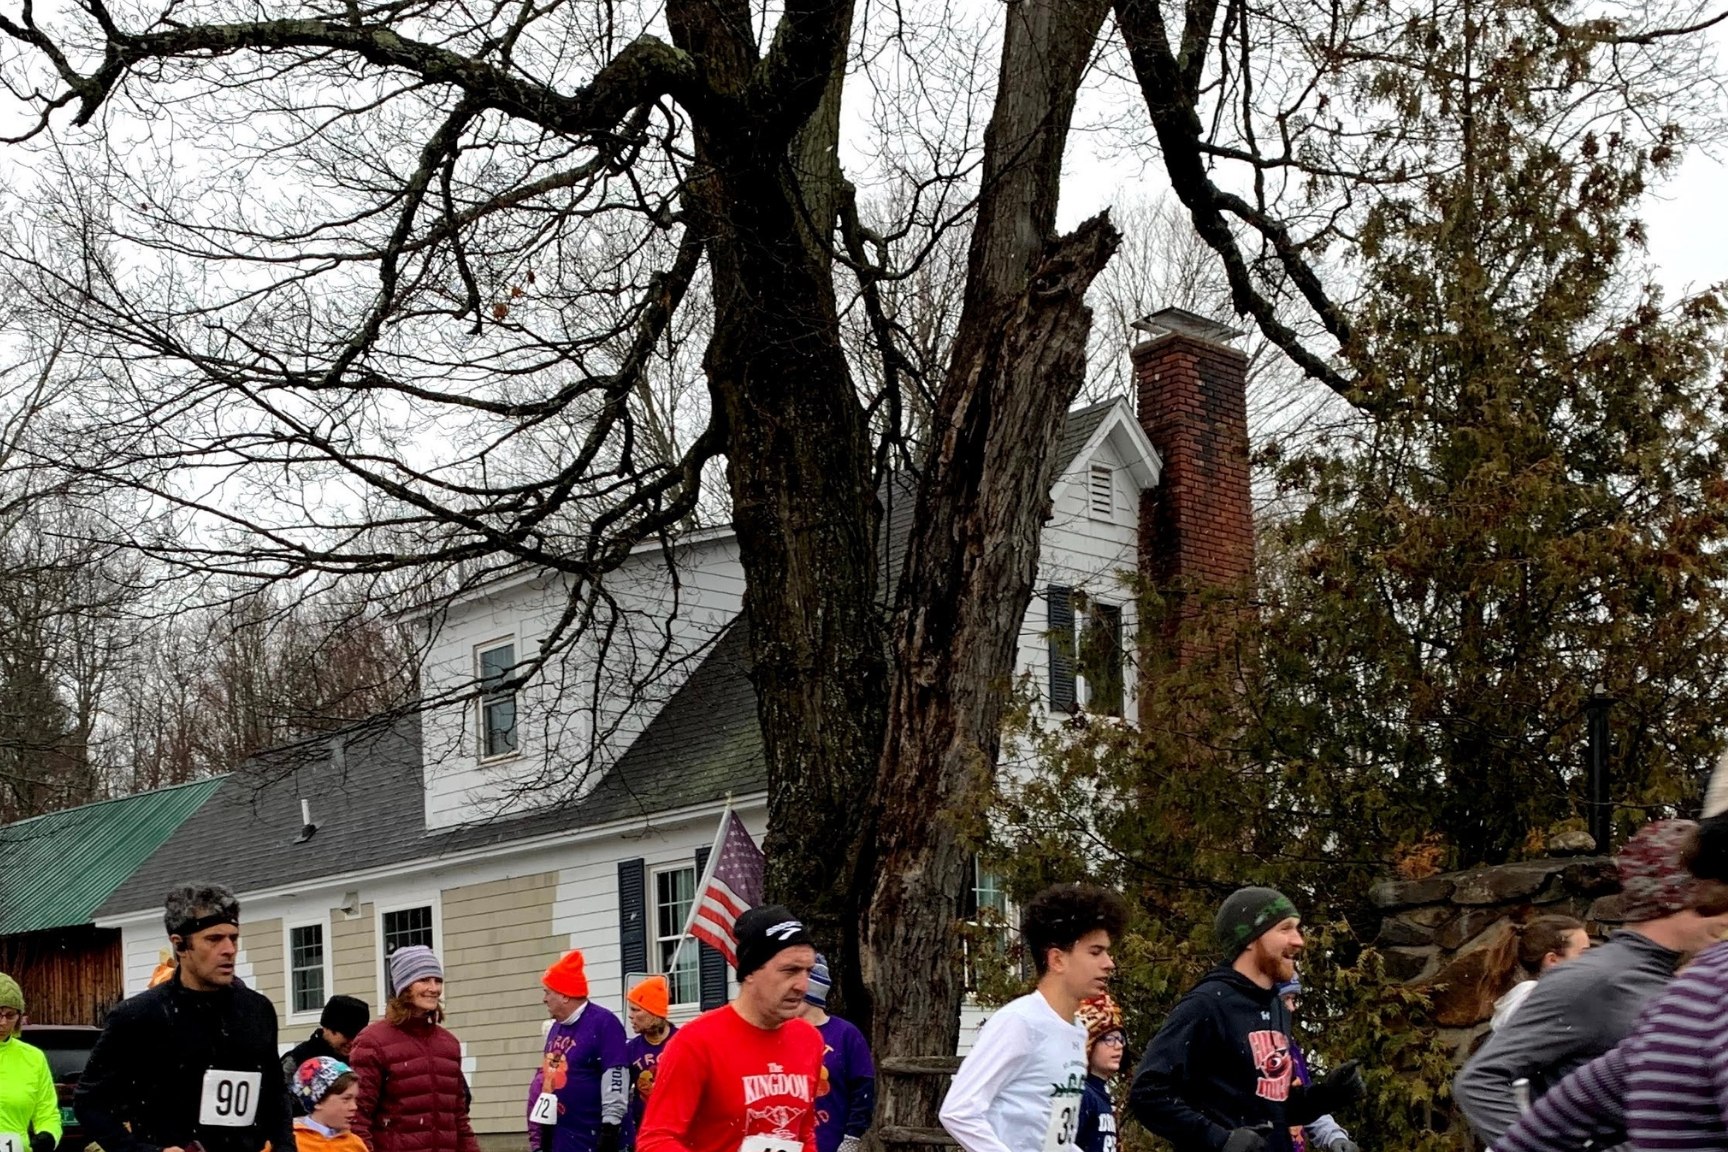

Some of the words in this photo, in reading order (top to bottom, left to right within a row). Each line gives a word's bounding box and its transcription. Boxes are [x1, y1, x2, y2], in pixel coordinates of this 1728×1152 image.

[767, 1062, 784, 1073] The
[215, 1079, 250, 1117] 90
[742, 1073, 810, 1105] KINGDOM
[535, 1097, 550, 1119] 72
